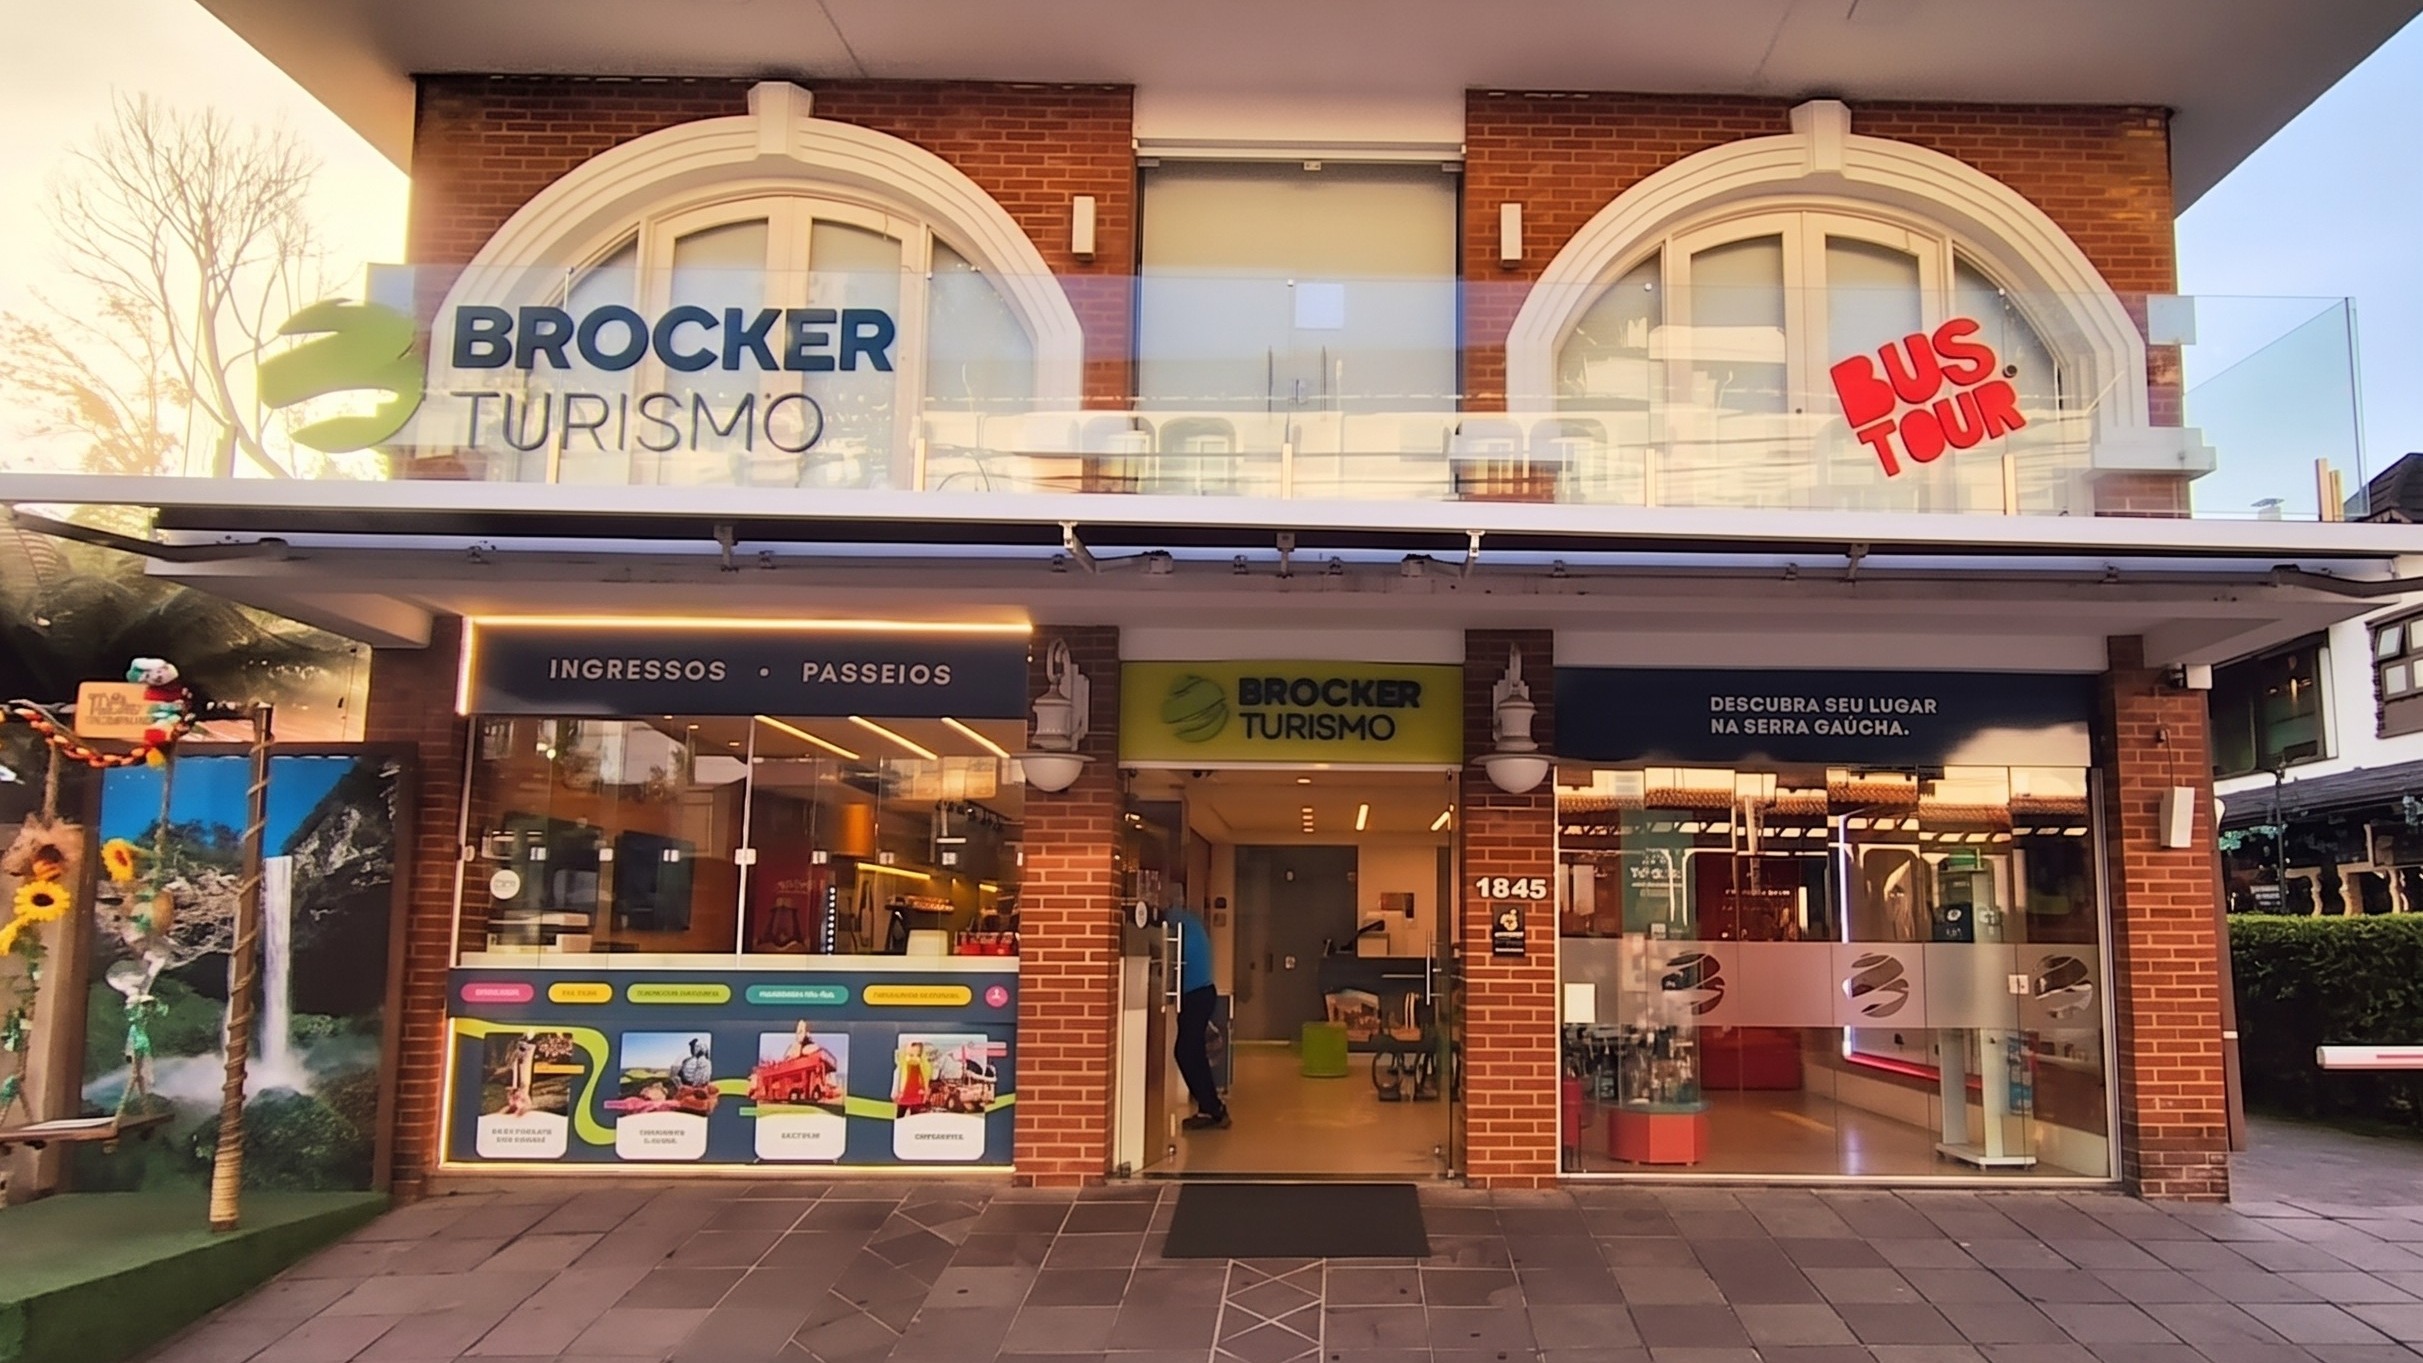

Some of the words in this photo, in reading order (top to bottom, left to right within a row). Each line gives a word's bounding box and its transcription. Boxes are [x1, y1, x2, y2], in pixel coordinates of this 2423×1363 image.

[452, 305, 895, 371] BROCKER
[1830, 318, 1996, 429] BUS
[450, 391, 825, 453] TURISMO
[1857, 380, 2026, 477] TOUR
[549, 658, 727, 681] INGRESSOS
[802, 662, 952, 685] PASSEIOS
[1238, 677, 1422, 709] BROCKER
[1710, 696, 1820, 713] DESCUBRA
[1825, 697, 1864, 714] SEU
[1868, 698, 1938, 715] LUGAR
[1239, 712, 1396, 741] TURISMO
[1710, 718, 1740, 735] NA
[1743, 719, 1810, 735] SERRA
[1814, 715, 1911, 736] GAÚCHA.
[1476, 877, 1547, 899] 1845
